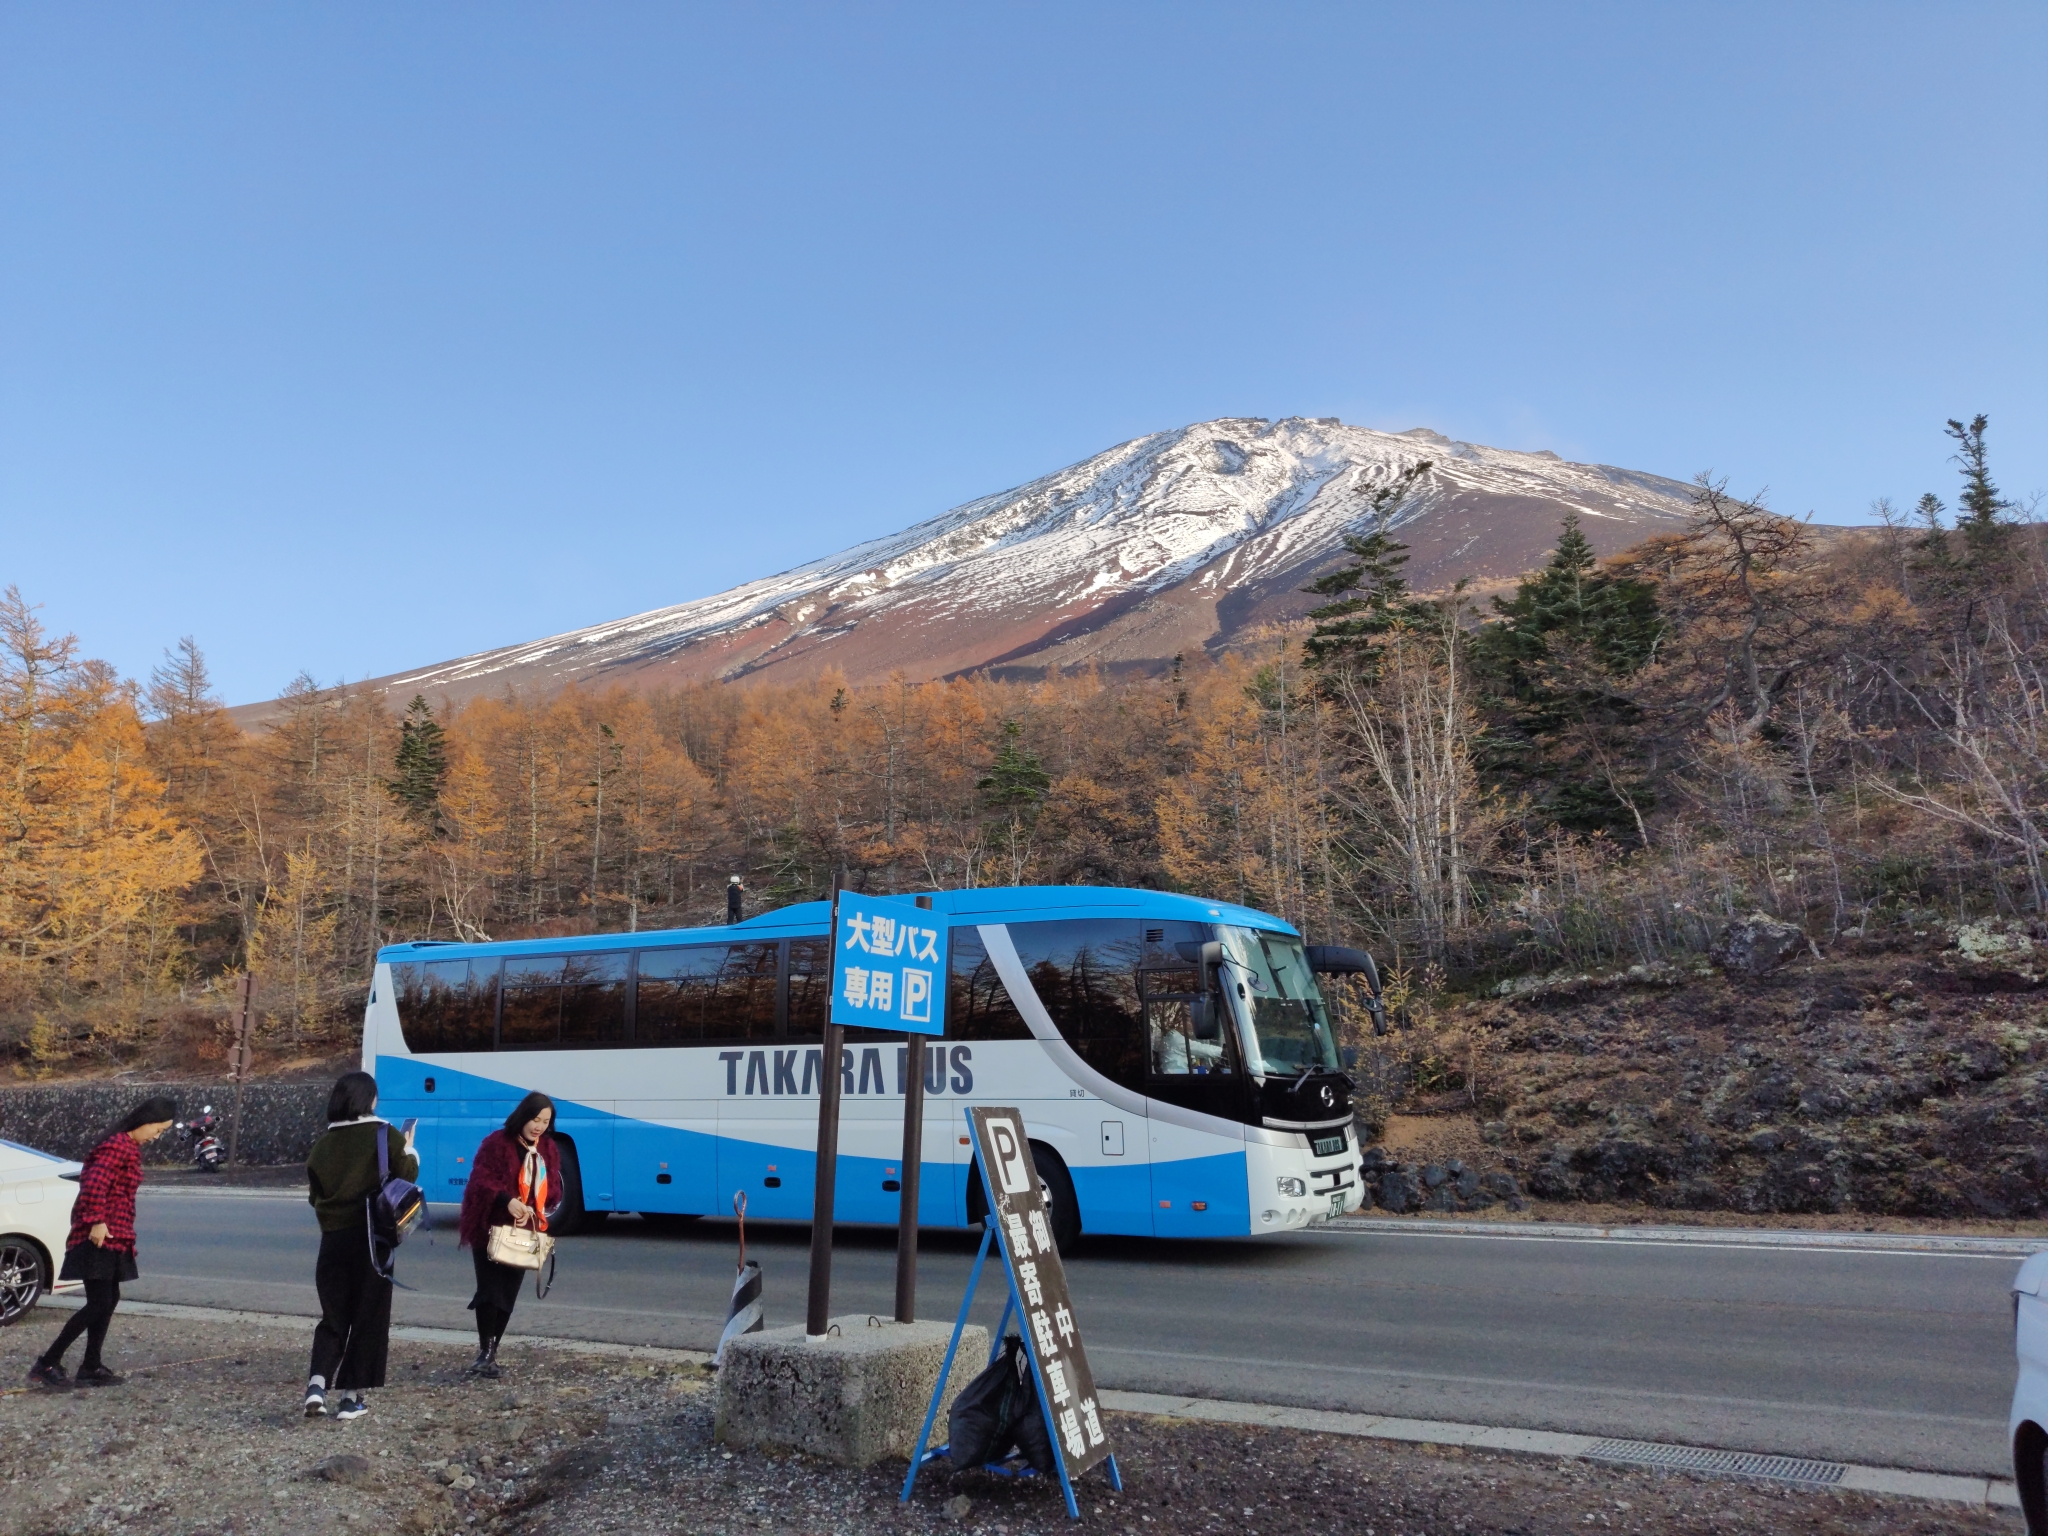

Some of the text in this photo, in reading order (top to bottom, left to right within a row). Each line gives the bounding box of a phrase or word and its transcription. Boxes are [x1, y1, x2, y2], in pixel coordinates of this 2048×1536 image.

[845, 912, 939, 964] 大型バス
[843, 966, 928, 1018] 専用 P
[718, 1048, 885, 1096] TAKARA
[1069, 1089, 1085, 1098] 貸切
[991, 1123, 1021, 1188] P
[1007, 1213, 1087, 1460] 最寄駐車場
